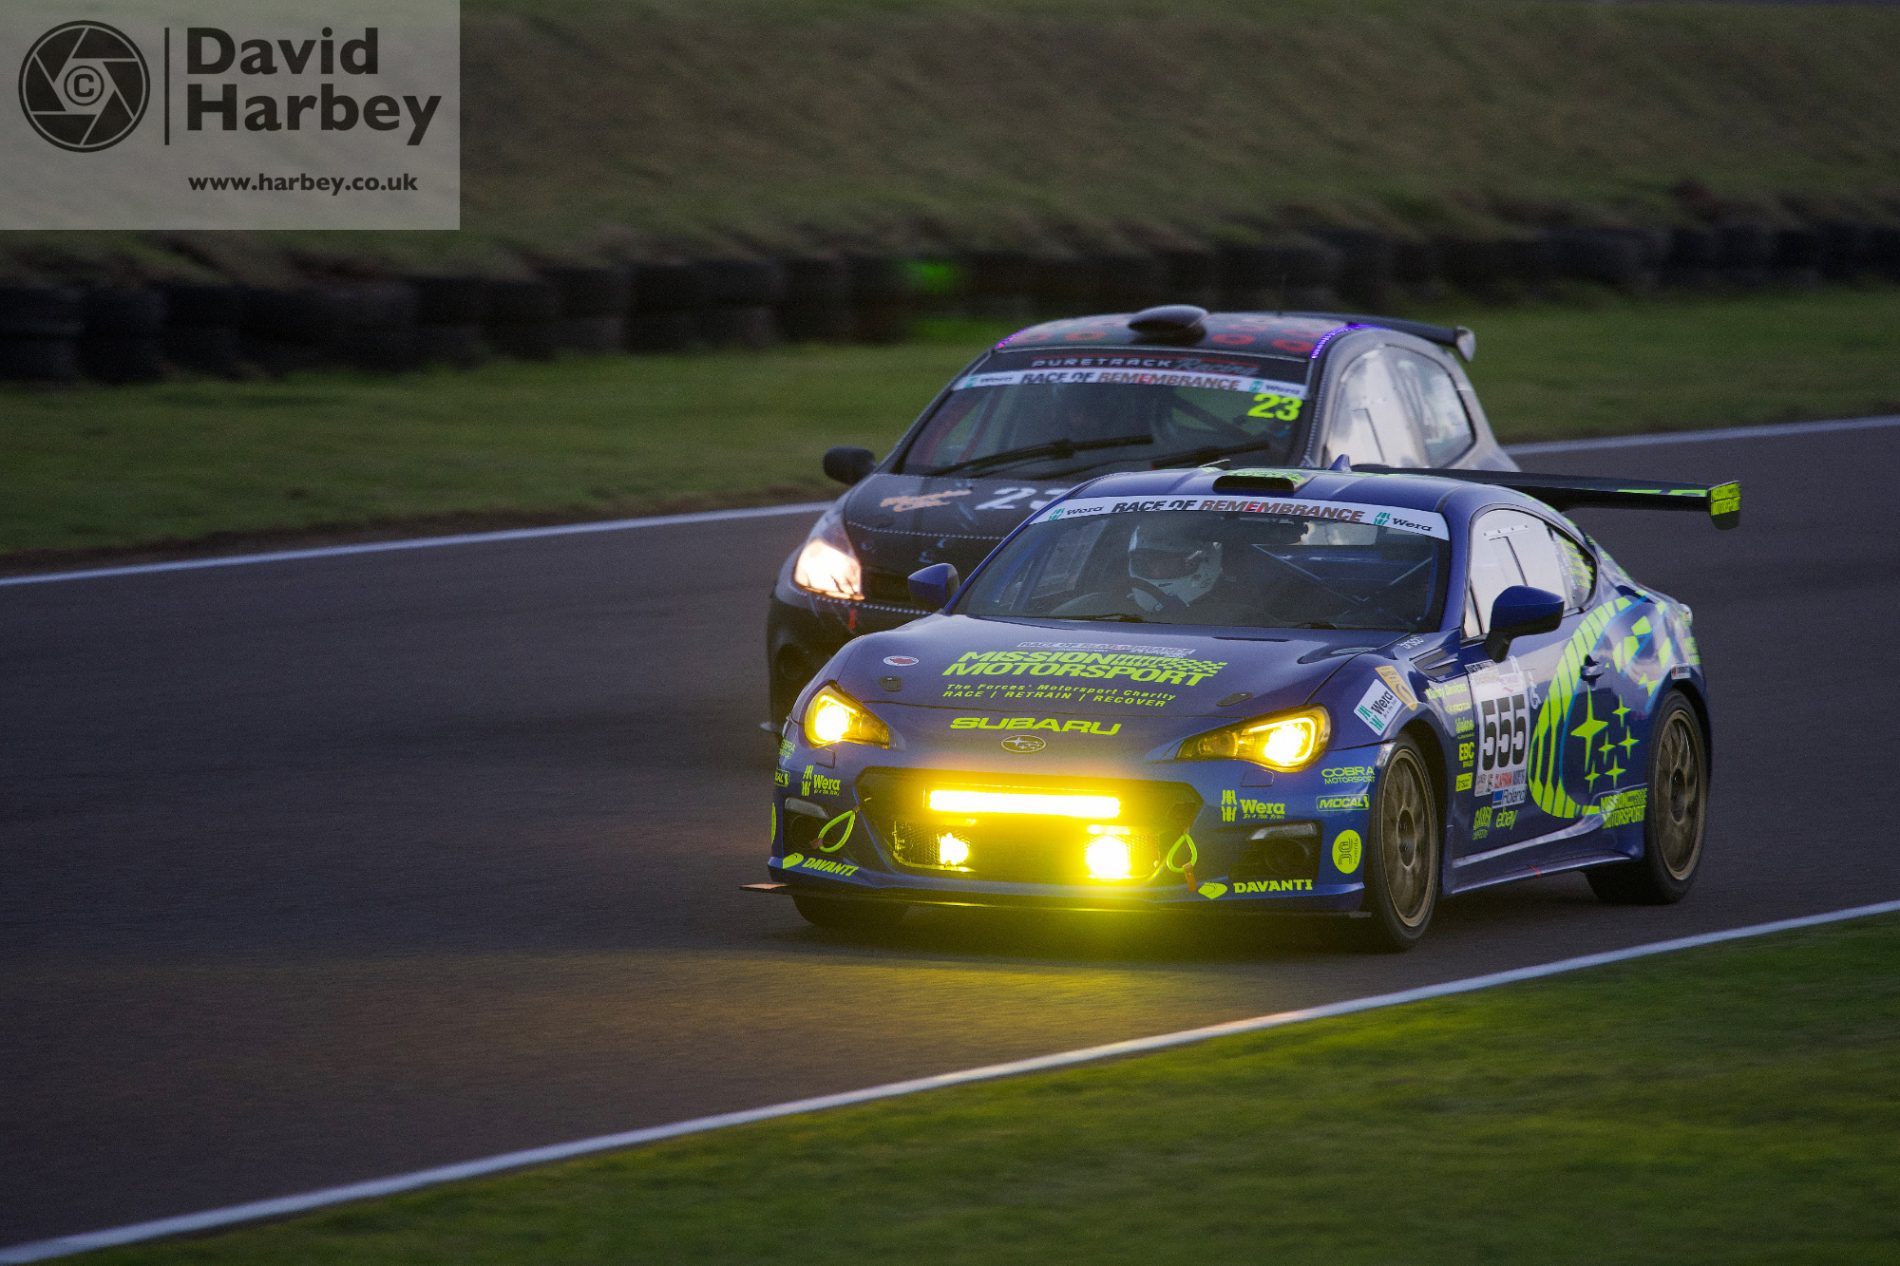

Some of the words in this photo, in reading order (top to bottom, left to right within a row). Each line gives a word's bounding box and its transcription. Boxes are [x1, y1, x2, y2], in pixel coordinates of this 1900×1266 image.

[1021, 373, 1068, 384] RACE
[1099, 372, 1241, 391] REMEMBRANCE
[1247, 393, 1303, 421] 23
[1111, 500, 1167, 513] RACE
[1168, 499, 1197, 511] OF
[1200, 499, 1365, 523] REMEMBRANCE
[1392, 517, 1433, 532] Wera
[957, 651, 1114, 664] MISSION
[941, 662, 1214, 687] MOTORSPORT
[1004, 691, 1072, 699] RETRAIN
[1093, 695, 1167, 708] RECOVER
[1037, 684, 1118, 695] Motorsport
[1123, 689, 1177, 701] Charity
[1371, 690, 1393, 714] Wera
[950, 717, 1122, 736] SUBARU
[1481, 694, 1527, 771] 555
[1321, 766, 1375, 778] COBRA
[813, 774, 841, 790] Wera
[1240, 799, 1285, 815] Wera
[802, 858, 859, 877] DAVANTI
[1234, 879, 1313, 894] DAVANTI
